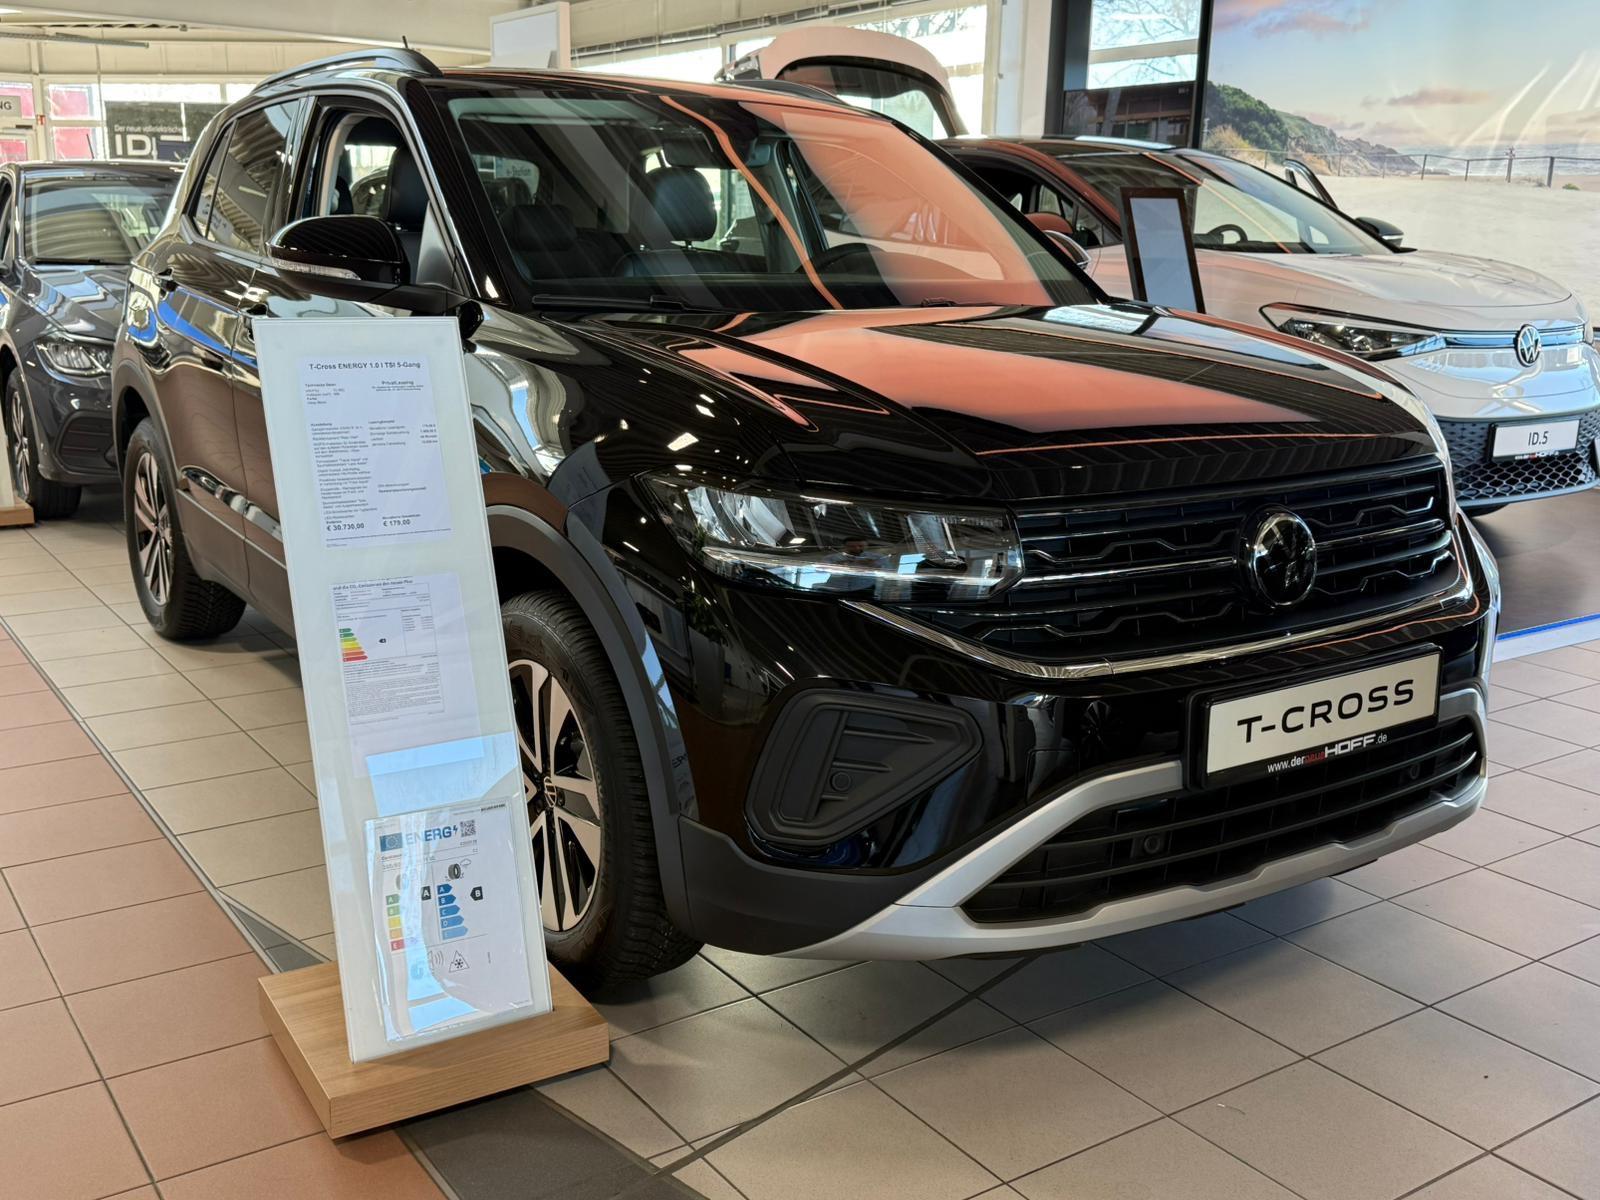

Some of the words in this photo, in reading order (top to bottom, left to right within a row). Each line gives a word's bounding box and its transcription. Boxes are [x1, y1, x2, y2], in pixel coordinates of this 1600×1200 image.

[397, 361, 421, 369] 5-Gang
[1528, 431, 1549, 446] ID.5
[333, 523, 365, 531] 30.730,00
[1237, 679, 1414, 743] T-CROSS
[423, 889, 430, 897] A
